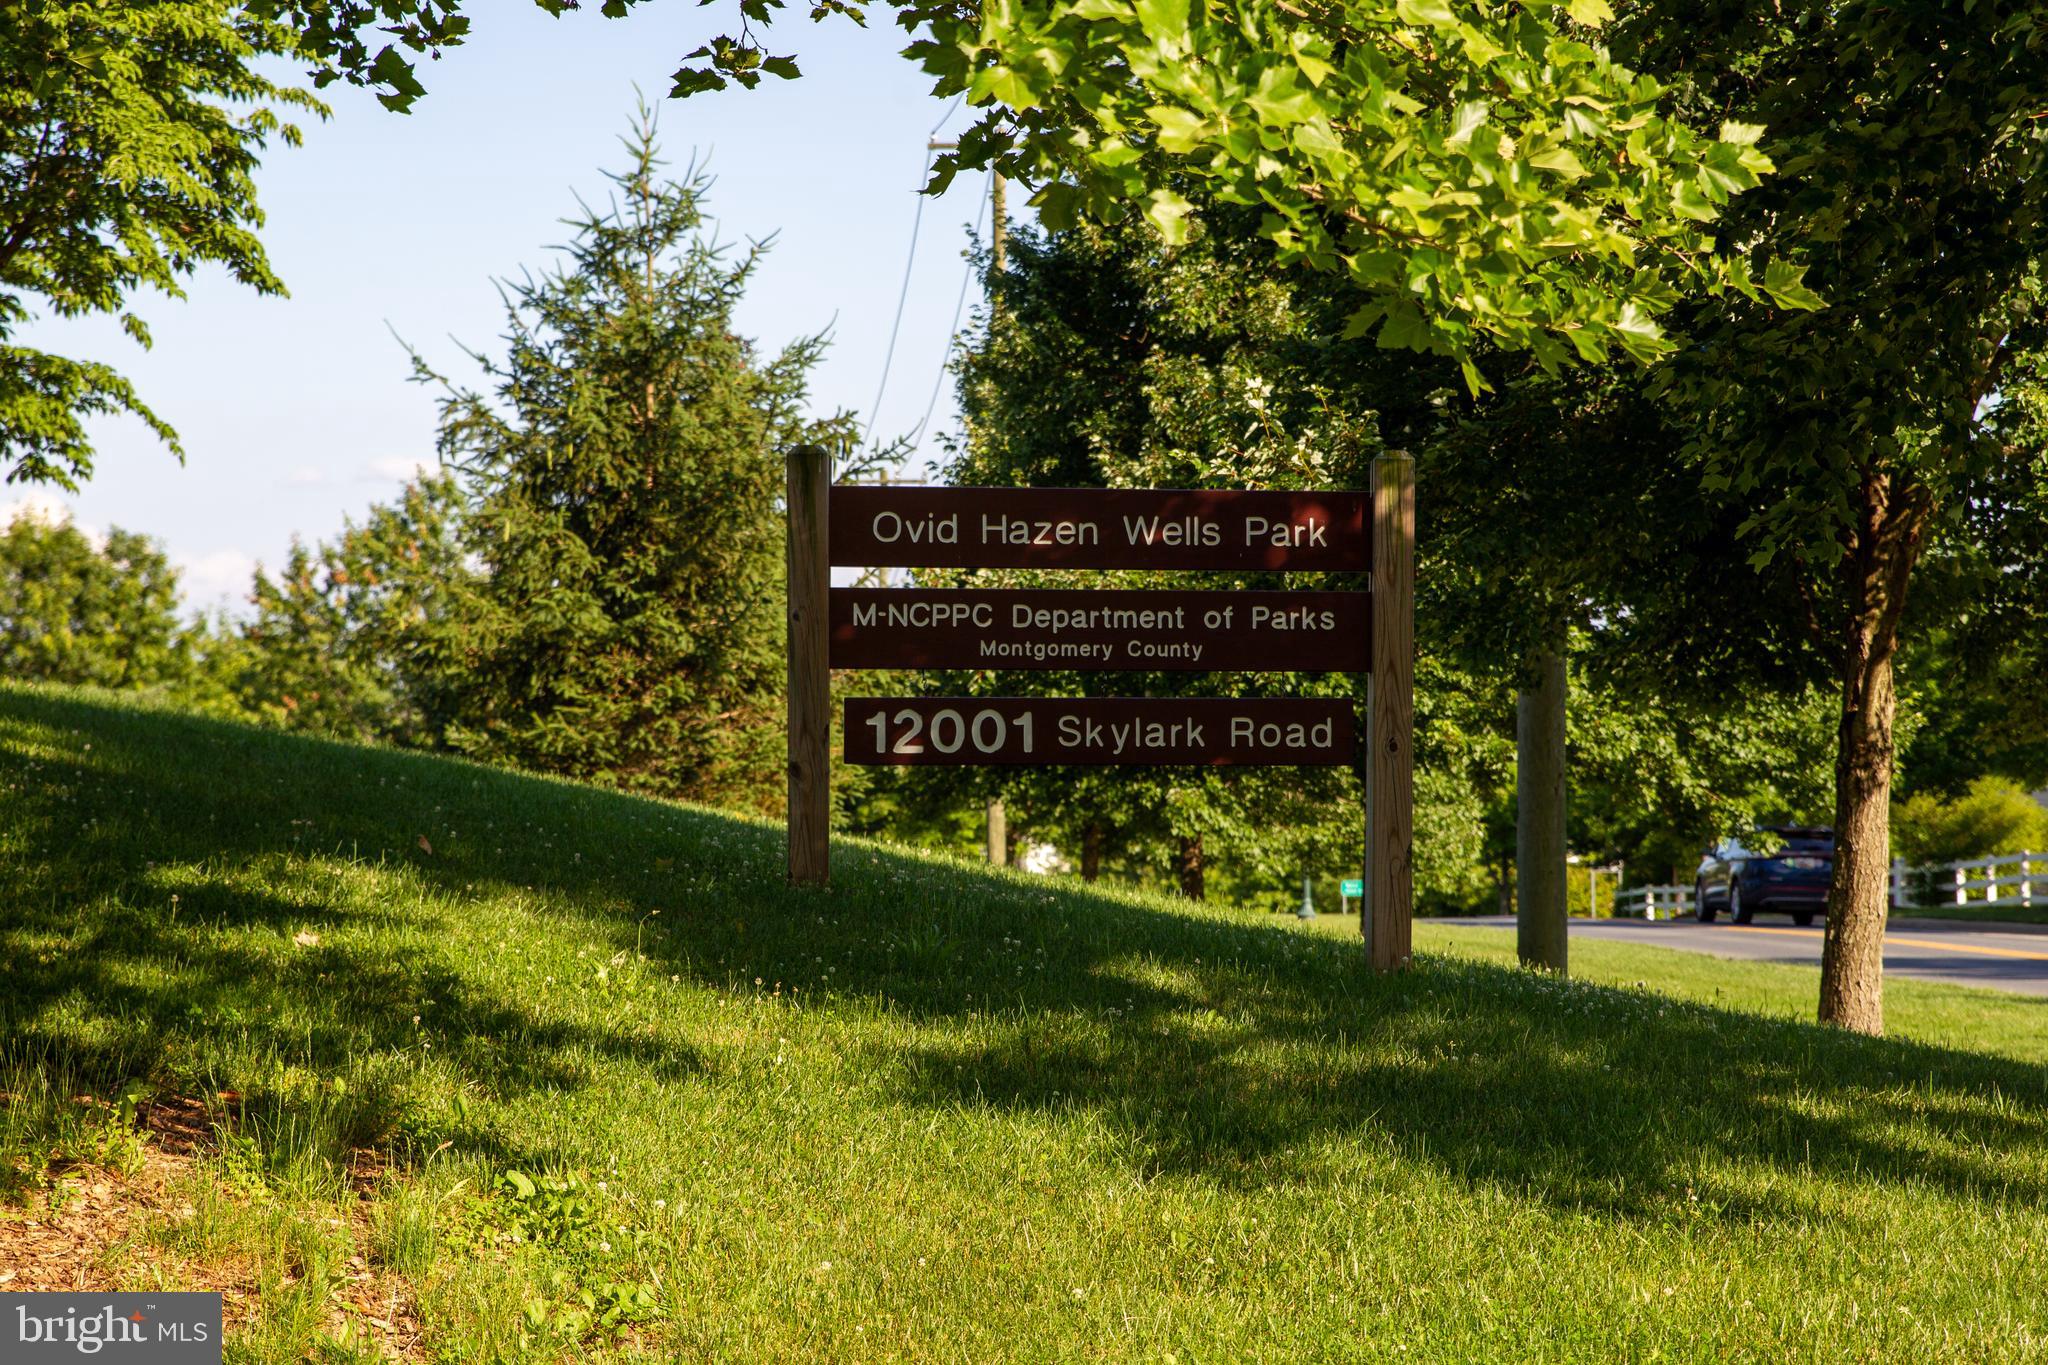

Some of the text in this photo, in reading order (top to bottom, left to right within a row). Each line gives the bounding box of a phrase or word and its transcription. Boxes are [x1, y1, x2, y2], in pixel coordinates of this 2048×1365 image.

[873, 512, 1327, 547] Ovid Hazen Wells Park
[854, 603, 1334, 633] M-NCPPC Department of Parks
[981, 640, 1202, 661] Montgomery County
[866, 709, 1331, 754] 12001 Skylark Road
